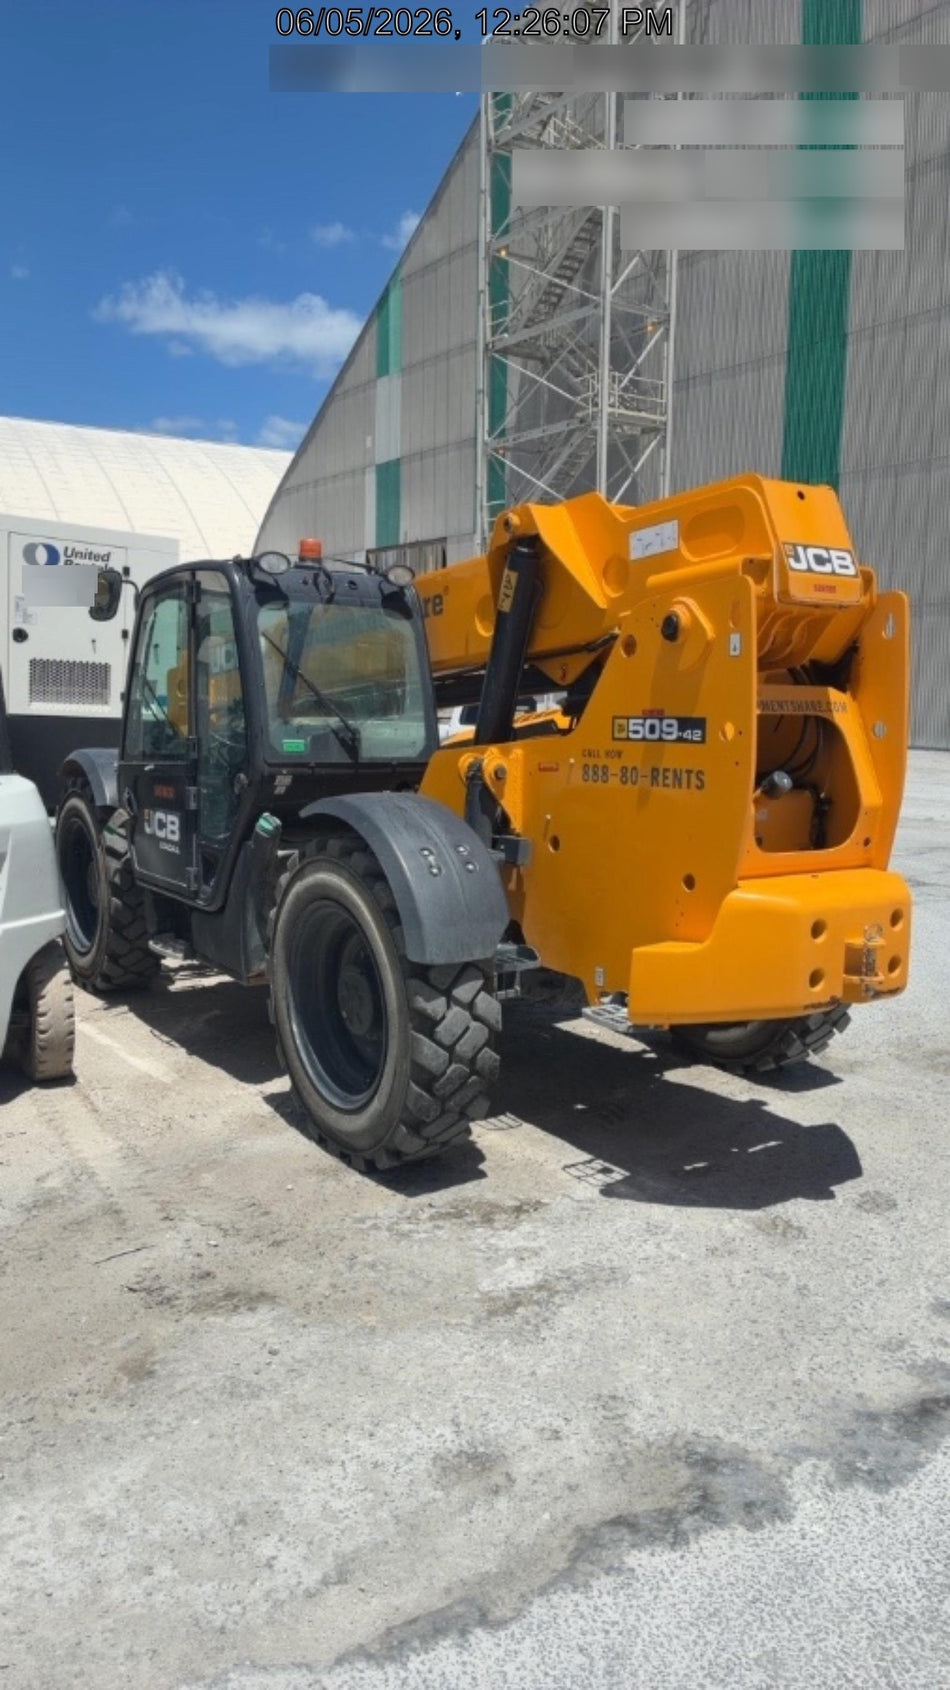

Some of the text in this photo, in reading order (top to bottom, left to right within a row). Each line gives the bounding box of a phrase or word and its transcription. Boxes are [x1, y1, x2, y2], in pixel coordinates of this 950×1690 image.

[63, 546, 111, 562] United
[787, 546, 858, 576] JCB
[581, 749, 624, 759] CALL NOW
[582, 763, 706, 791] 888-80-RENTS
[144, 809, 180, 842] JCB
